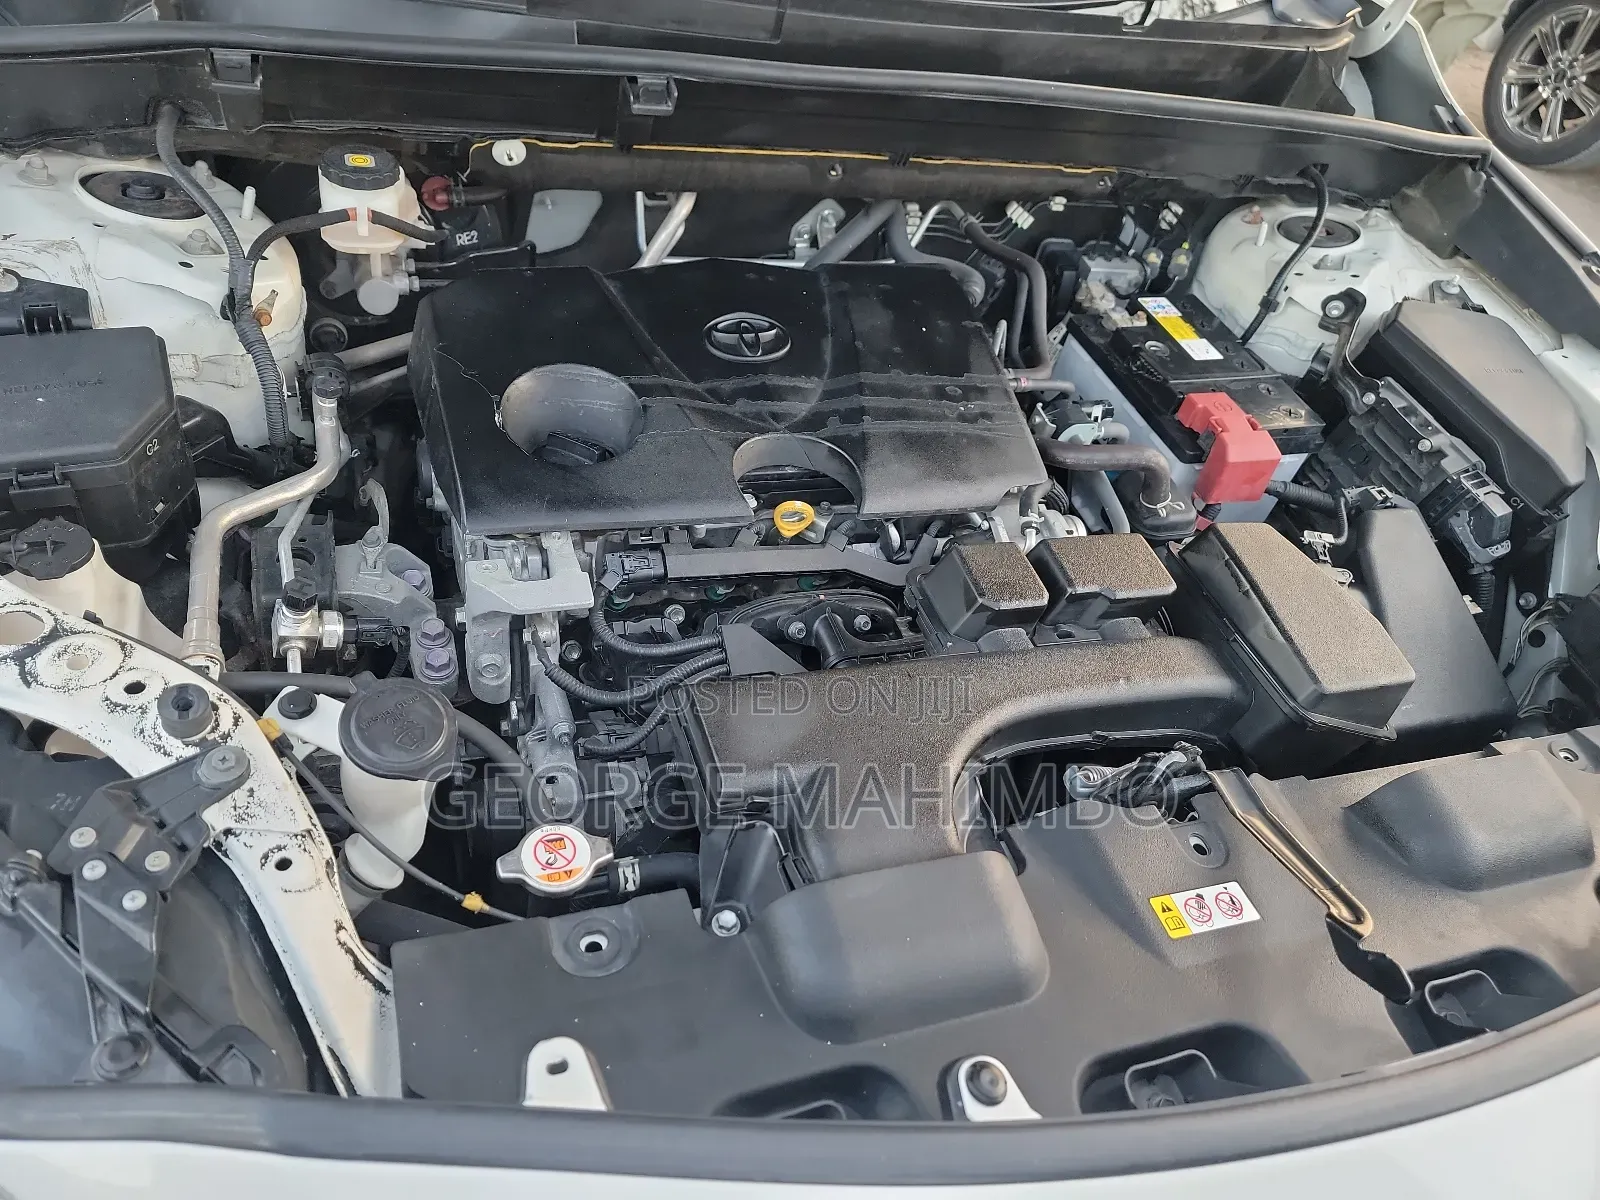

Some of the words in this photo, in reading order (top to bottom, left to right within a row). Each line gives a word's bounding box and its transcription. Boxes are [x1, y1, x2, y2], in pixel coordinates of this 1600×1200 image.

[455, 230, 479, 247] RE2
[1510, 496, 1525, 510] C1
[360, 707, 396, 729] WASHER
[396, 694, 420, 709] FLUID
[385, 710, 406, 725] ONLY
